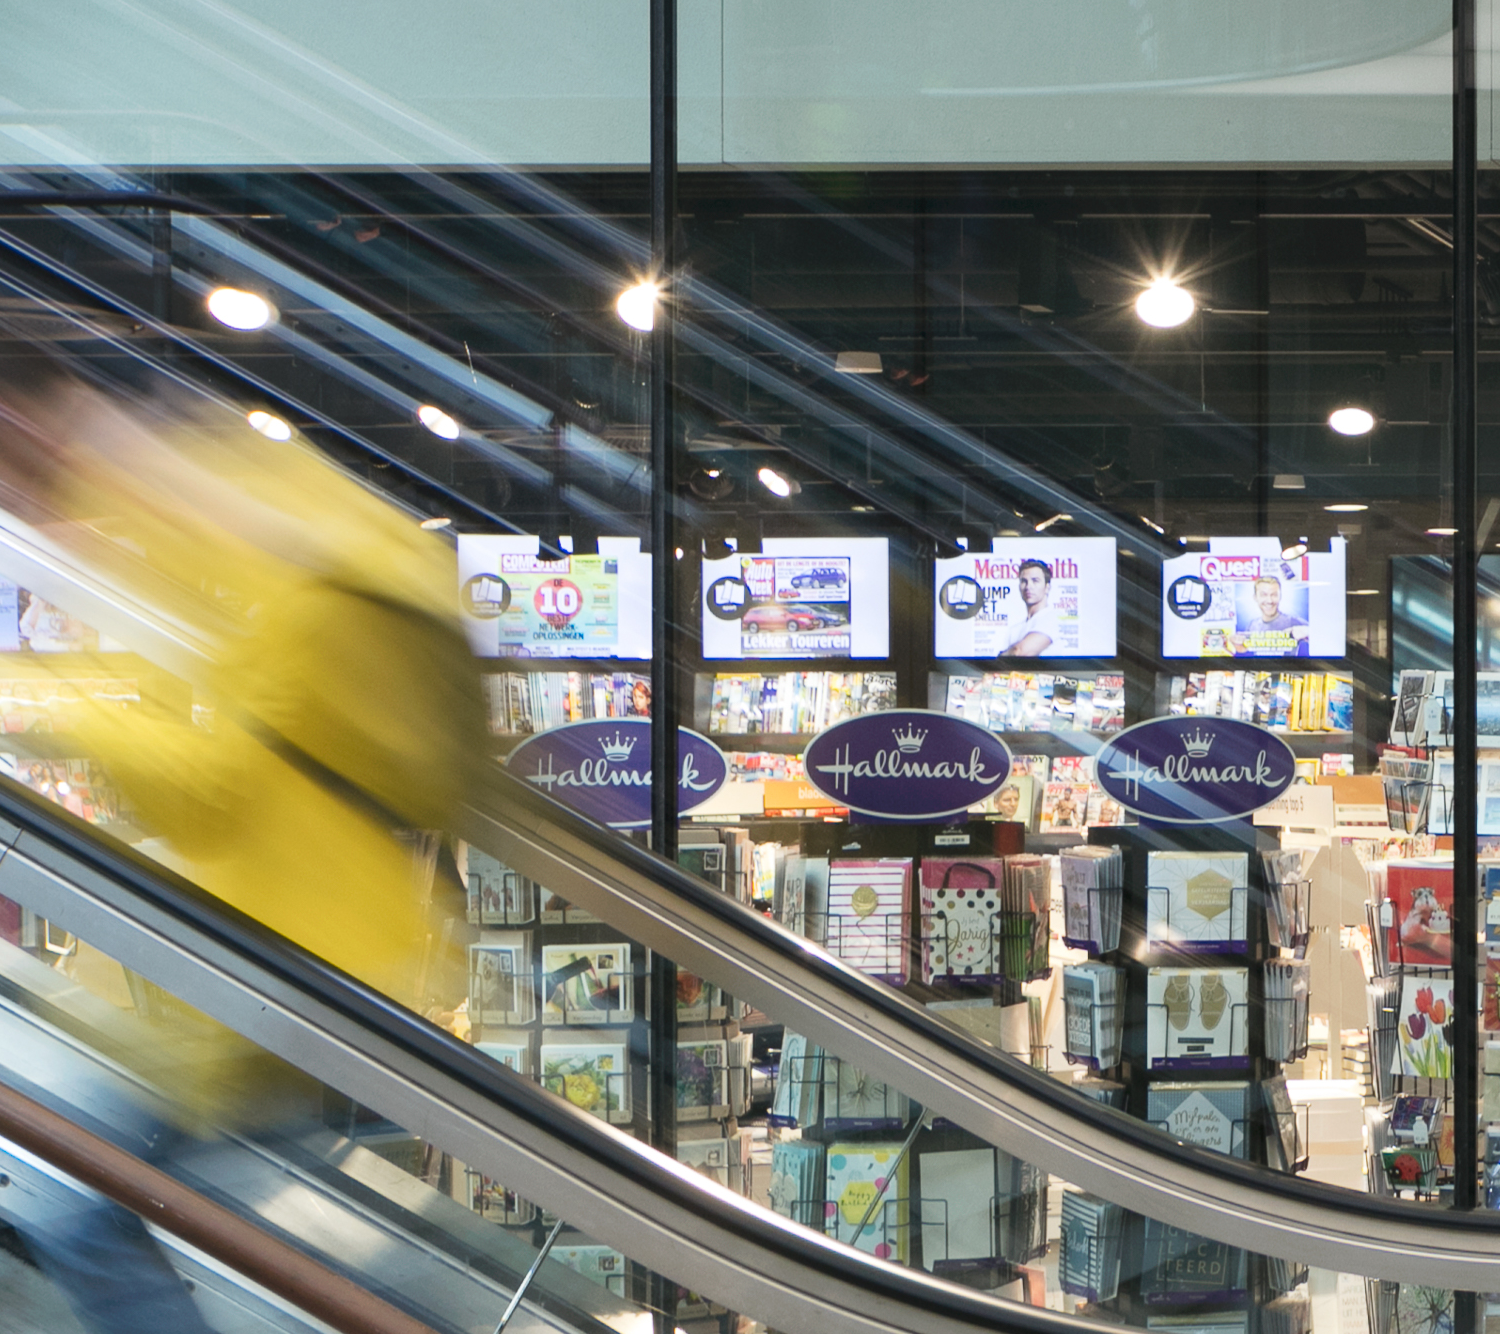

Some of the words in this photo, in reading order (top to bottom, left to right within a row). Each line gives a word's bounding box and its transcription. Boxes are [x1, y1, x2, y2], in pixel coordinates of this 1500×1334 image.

[974, 558, 1019, 580] Men's
[1201, 557, 1260, 581] Quest
[540, 587, 578, 615] 10
[533, 632, 584, 640] OPLOSSINGEN
[743, 633, 788, 649] Lekker
[790, 633, 850, 649] Toureren
[525, 752, 717, 792] Hallmak
[815, 743, 1001, 796] Hallmark
[1107, 749, 1287, 801] Hallmark
[946, 919, 990, 955] Jarig
[1165, 1259, 1222, 1275] TEERD
